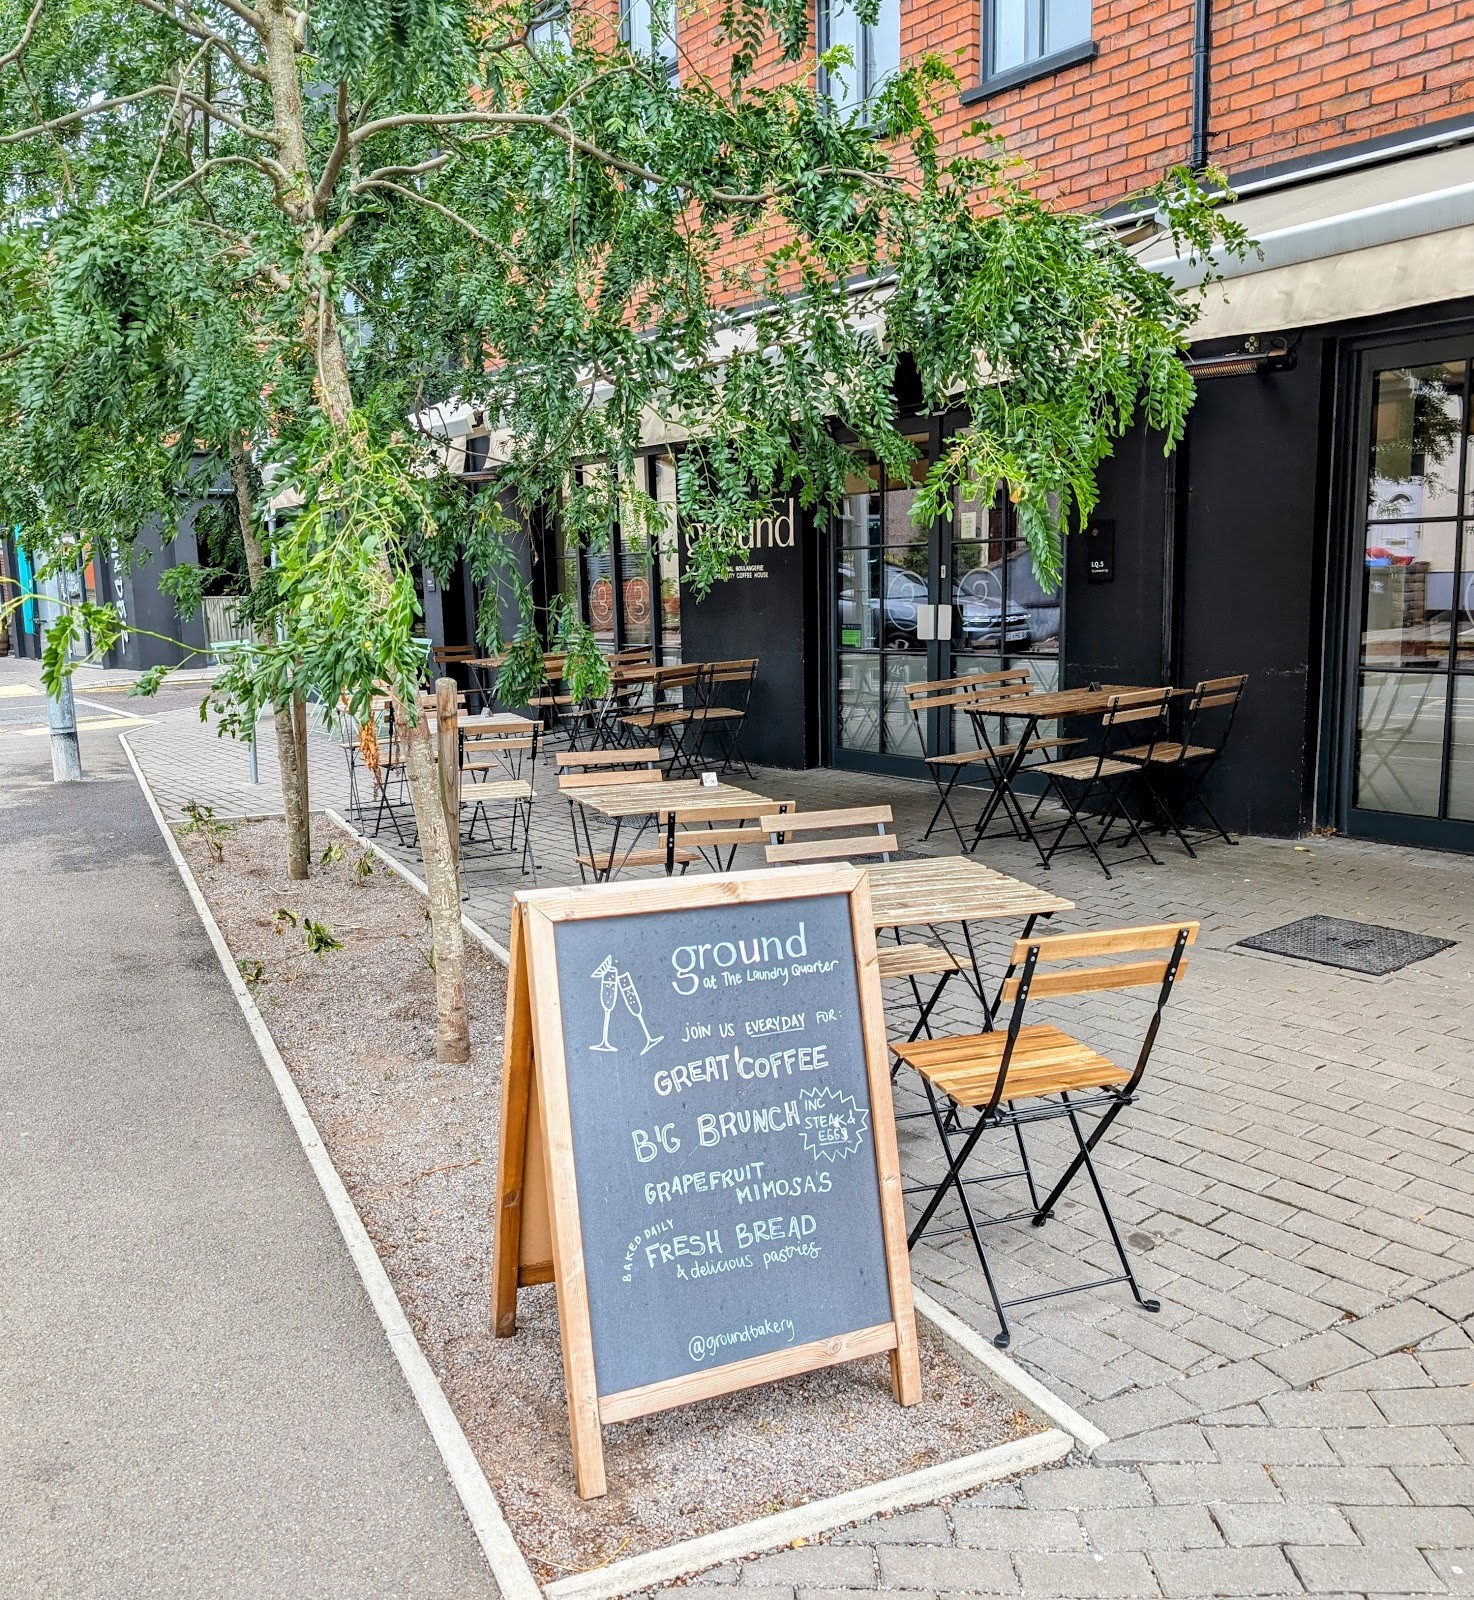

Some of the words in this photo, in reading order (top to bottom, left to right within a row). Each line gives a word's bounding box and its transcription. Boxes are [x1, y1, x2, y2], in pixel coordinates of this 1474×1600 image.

[685, 497, 795, 575] gound
[672, 921, 808, 995] ground
[703, 976, 718, 990] at
[721, 971, 743, 987] The
[747, 966, 789, 987] Laundry
[791, 960, 839, 976] Quarter
[719, 1022, 735, 1038] US
[745, 1013, 806, 1036] EVERYDAY
[816, 1008, 843, 1024] FOR:
[654, 1054, 730, 1096] GREAT
[737, 1045, 830, 1080] COFFEE
[804, 1098, 826, 1111] INC
[804, 1113, 847, 1129] STEAK
[632, 1122, 681, 1163] BIG
[697, 1100, 801, 1147] BRUNCH
[644, 1161, 765, 1205] GRAPEFRUIT
[622, 1235, 642, 1283] BAKED
[644, 1218, 675, 1240] DAILY
[645, 1229, 723, 1269] FRESH
[735, 1214, 817, 1249] BREAD
[690, 1254, 754, 1279] delicious
[763, 1241, 822, 1270] pastries
[688, 1317, 795, 1362] @groundbakery
